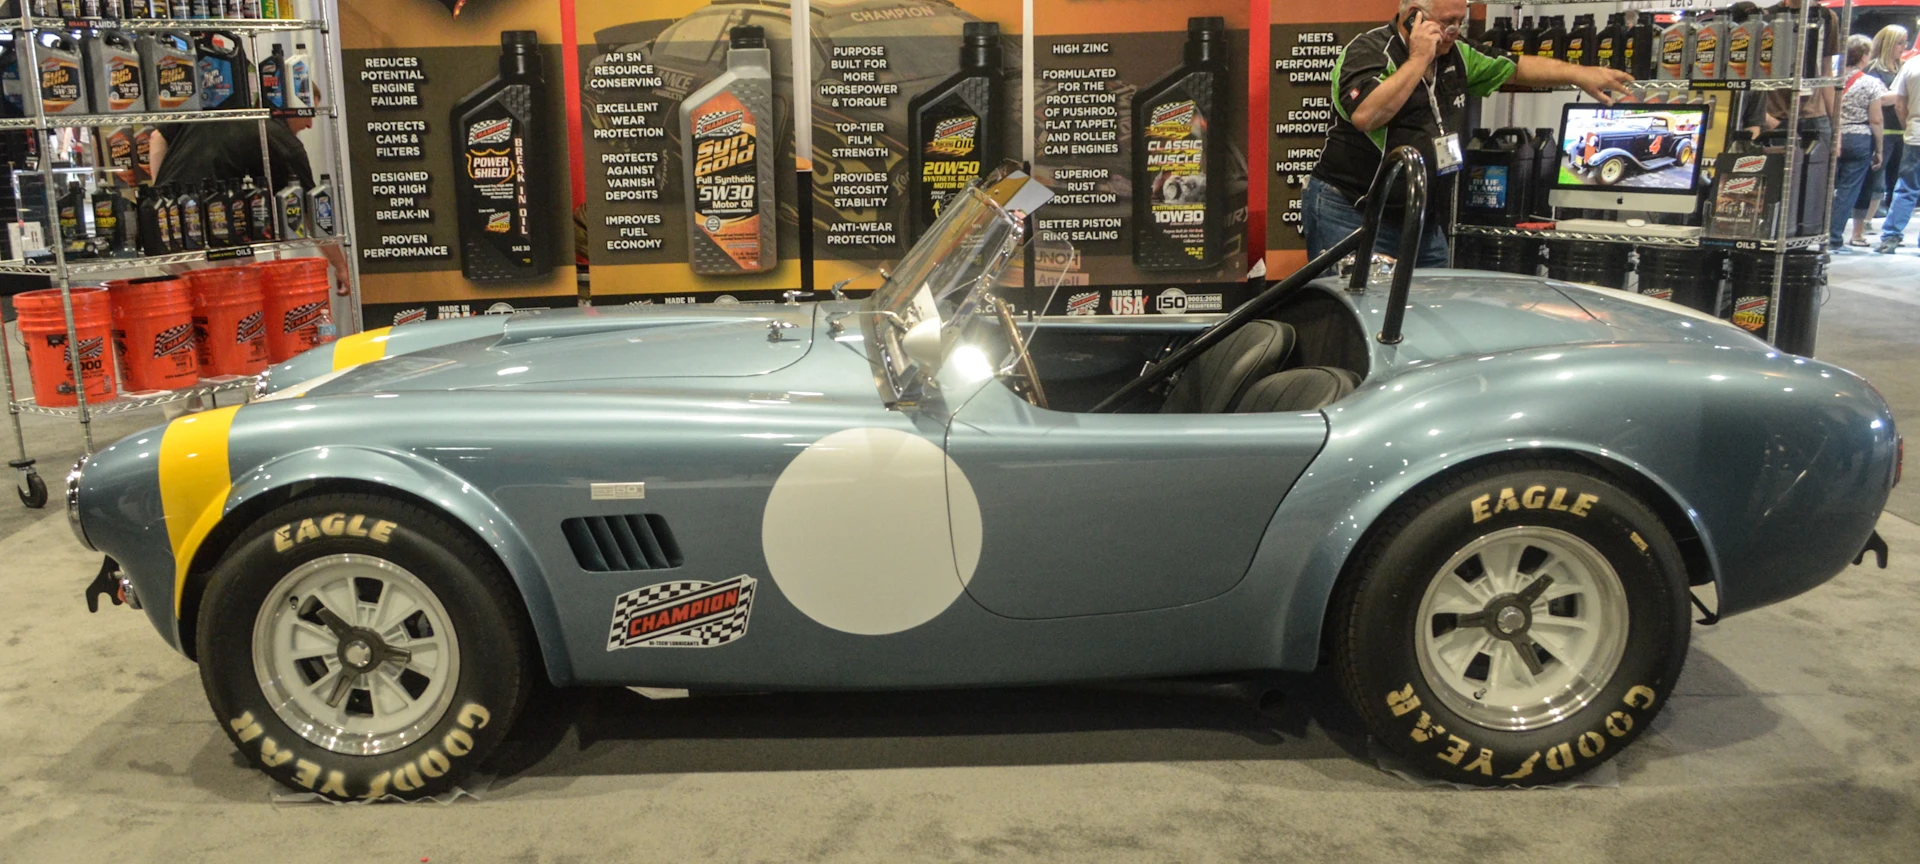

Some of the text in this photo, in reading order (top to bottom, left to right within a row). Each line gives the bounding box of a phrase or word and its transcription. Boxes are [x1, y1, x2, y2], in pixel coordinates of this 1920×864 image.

[851, 6, 935, 22] CHAMPION
[90, 20, 116, 28] FLUIDS
[1298, 33, 1334, 43] MEETS
[834, 47, 884, 56] PURPOSE
[1053, 43, 1108, 54] HIGH ZINC
[1292, 46, 1342, 56] EXTREME
[365, 57, 418, 68] REDUCES
[606, 53, 641, 62] API SN
[831, 59, 886, 69] BUILT FOR
[1276, 59, 1337, 69] PERFORMA
[361, 70, 424, 80] POTENTIAL
[595, 65, 653, 75] RESOURCE
[1043, 69, 1116, 79] FORMULATED
[843, 72, 875, 81] MORE
[591, 77, 662, 88] CONSERVING
[1058, 82, 1104, 92] FOR THE
[372, 83, 415, 93] ENGINE
[821, 85, 897, 94] HORSEPOWER
[371, 96, 418, 106] FAILURE
[832, 97, 887, 107] & TORQUE
[1046, 94, 1116, 104] PROTECTION
[1302, 98, 1330, 107] FUEL
[596, 103, 658, 113] EXCELLENT
[1045, 106, 1117, 117] OF PUSHROD,
[1157, 106, 1192, 122] CHAMPION
[1288, 110, 1330, 120] ECONO
[611, 116, 645, 125] WEAR
[702, 116, 739, 134] CHAMPION
[1046, 119, 1117, 129] FLAT TAPPET,
[368, 121, 426, 132] PROTECTS
[474, 122, 508, 140] CHAMPION
[835, 123, 884, 132] TOP-TIER
[940, 122, 973, 136] CHAMPION
[1276, 124, 1328, 133] IMPROVE
[594, 128, 663, 139] PROTECTION
[1047, 132, 1116, 142] AND ROLLER
[376, 134, 418, 144] CAMS &
[847, 135, 872, 144] FILM
[954, 140, 975, 148] OIL
[697, 134, 749, 160] Syn
[1044, 144, 1118, 155] CAM ENGINES
[1148, 140, 1202, 150] CLASSIC
[1649, 135, 1663, 155] 4
[376, 147, 420, 157] FILTERS
[832, 148, 888, 157] STRENGTH
[1288, 149, 1321, 159] IMPRO
[473, 156, 508, 168] POWER
[602, 153, 658, 163] PROTECTS
[694, 144, 755, 176] Gold
[1148, 154, 1202, 165] MUSCLE
[607, 165, 654, 176] AGAINST
[923, 161, 980, 175] 20W50
[1276, 162, 1316, 172] HORSE
[372, 172, 428, 182] DESIGNED
[474, 168, 510, 178] SHIELD
[834, 173, 887, 182] PROVIDES
[1055, 169, 1108, 179] SUPERIOR
[608, 178, 655, 188] VARNISH
[696, 175, 755, 184] Full Synthetic
[1287, 175, 1295, 184] &
[373, 184, 426, 195] FOR HIGH
[514, 138, 528, 234] BREAK IN OIL
[833, 185, 888, 195] VISCOSITY
[1068, 182, 1095, 191] RUST
[606, 190, 658, 200] DEPOSITS
[699, 185, 754, 200] 5W30
[390, 198, 413, 207] RPM
[712, 201, 738, 209] Motor
[741, 199, 753, 208] Oil
[834, 198, 888, 207] STABILITY
[286, 207, 300, 215] CVT
[376, 209, 429, 220] BREAK-IN
[606, 215, 661, 225] IMPROVES
[1154, 210, 1204, 223] 10W30
[830, 223, 892, 232] ANTI-WEAR
[1039, 218, 1121, 229] BETTER PISTON
[620, 228, 648, 237] FUEL
[1043, 231, 1118, 242] RING SEALING
[382, 235, 428, 245] PROVEN
[607, 239, 662, 250] ECONOMY
[827, 235, 896, 244] PROTECTION
[1736, 241, 1756, 249] OILS
[236, 248, 253, 256] OILS
[364, 246, 448, 258] PERFORMANCE
[1111, 297, 1145, 314] USA
[1158, 296, 1185, 309] ISO
[1471, 485, 1599, 524] EAGLE
[274, 512, 398, 552] EAGLE
[629, 589, 739, 636] CHAMPION
